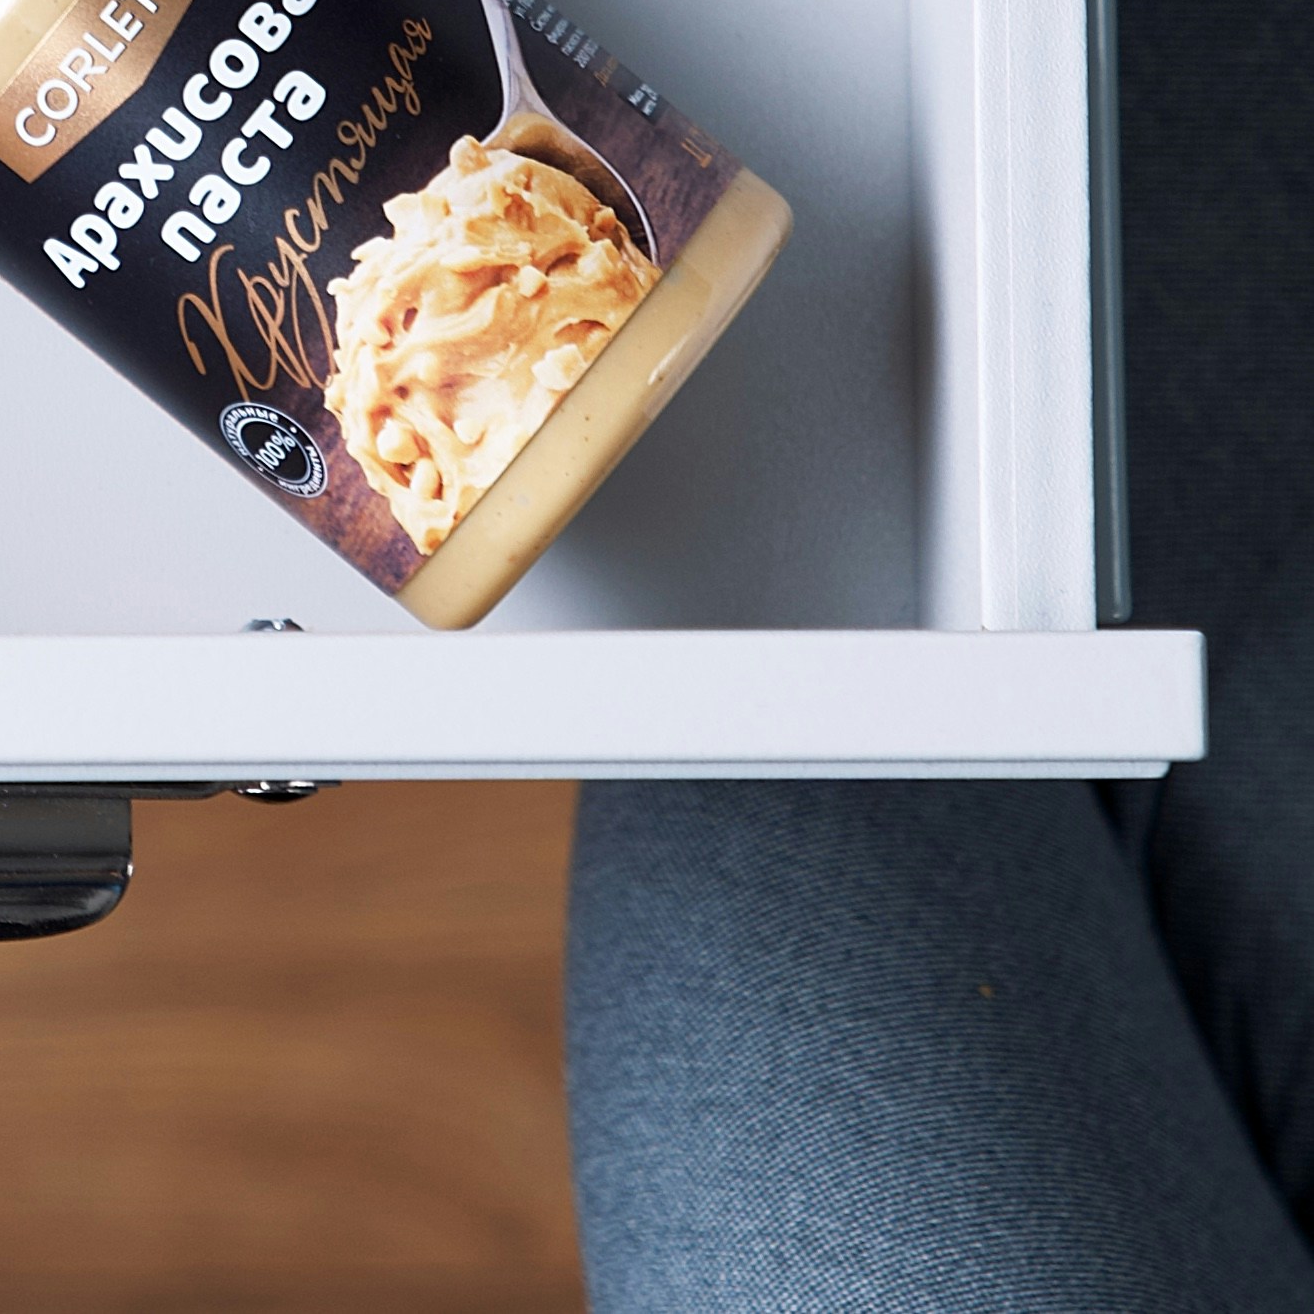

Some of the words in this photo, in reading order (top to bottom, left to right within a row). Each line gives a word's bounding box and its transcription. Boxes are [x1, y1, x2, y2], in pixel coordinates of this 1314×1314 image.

[160, 69, 327, 263] паста
[177, 17, 432, 403] Хрустящая
[255, 429, 297, 471] 100%
